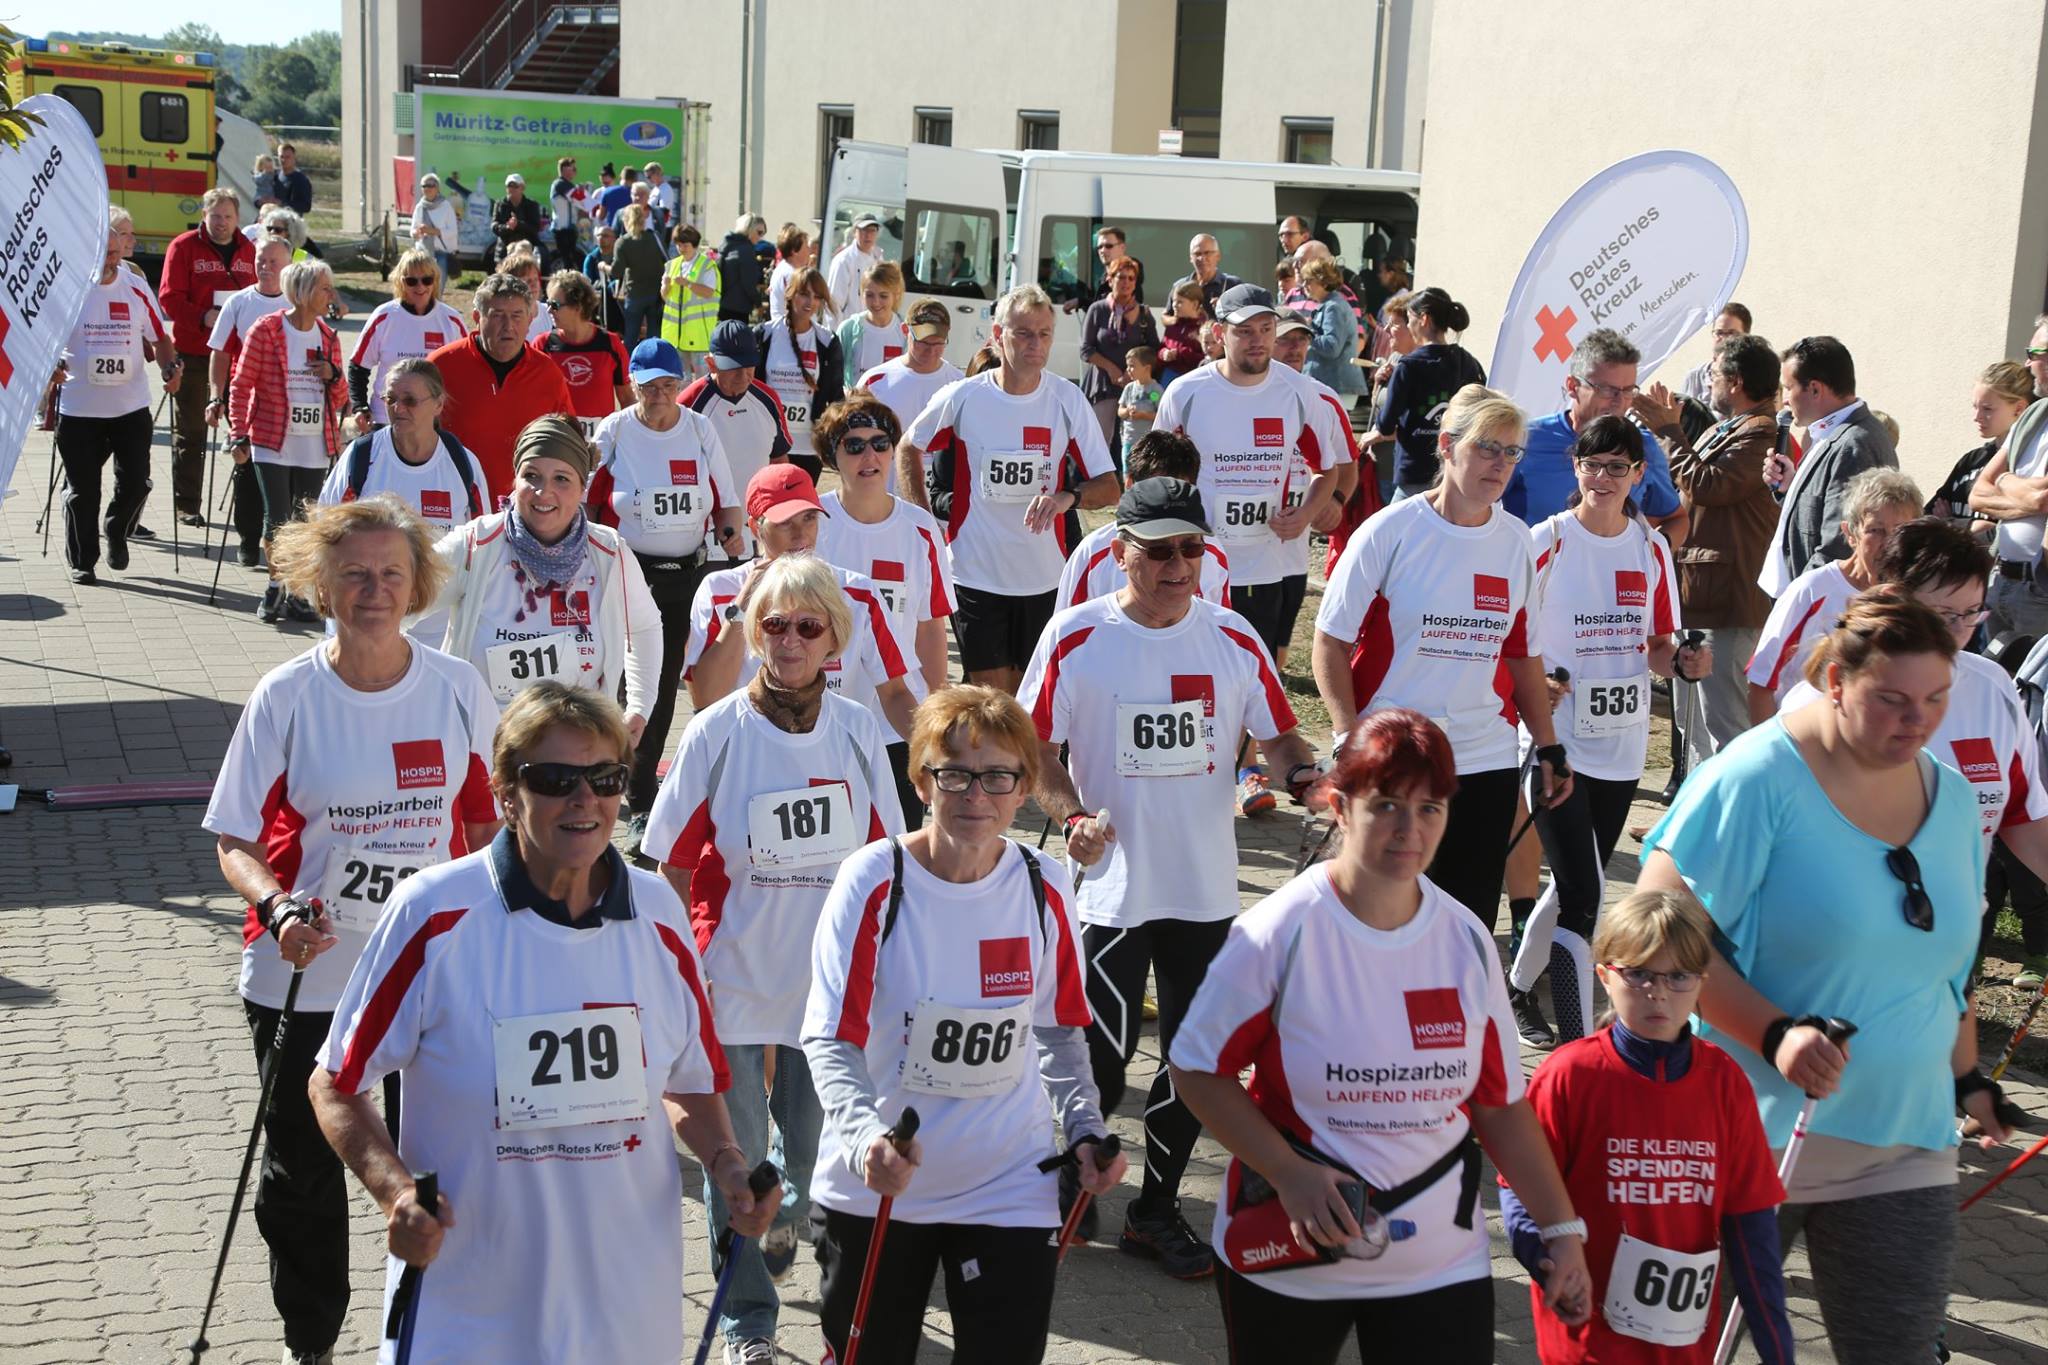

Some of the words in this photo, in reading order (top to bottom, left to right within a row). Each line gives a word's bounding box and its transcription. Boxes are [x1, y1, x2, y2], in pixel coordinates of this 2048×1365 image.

[435, 111, 612, 136] Müritz-Getränke
[0, 145, 63, 280] Deutsches
[1569, 206, 1660, 291] Deutsches
[7, 226, 48, 304] Rotes
[20, 250, 63, 329] Kreuz
[1580, 258, 1631, 307] Rotes
[1590, 275, 1643, 325] Kreuz
[1640, 271, 1700, 320] Menschen.
[95, 358, 125, 374] 284
[292, 407, 320, 424] 556
[1214, 451, 1283, 463] Hospizarbeit
[990, 460, 1034, 485] 585
[654, 492, 692, 516] 514
[1226, 501, 1267, 526] 584
[1476, 594, 1508, 605] HOSPIZ
[1422, 614, 1508, 631] Hospizarbeit
[1575, 628, 1614, 638] LAUFEND
[1421, 630, 1467, 640] LAUFEND
[509, 644, 557, 679] 311
[1590, 685, 1639, 716] 533
[1134, 712, 1195, 750] 636
[400, 766, 443, 778] HOSPIZ
[328, 795, 443, 819] Hospizarbeit
[773, 796, 830, 840] 187
[331, 821, 389, 836] LAUFEND
[392, 817, 442, 829] HELFEN
[371, 841, 397, 849] Rotes
[399, 841, 425, 849] Kreuz
[751, 875, 790, 884] Deutsches
[985, 971, 1031, 985] HOSPIZ
[1415, 1022, 1463, 1036] HOSPIZ
[931, 1018, 1016, 1066] 866
[528, 1024, 619, 1086] 219
[1326, 1060, 1468, 1087] Hospizarbeit
[1326, 1090, 1406, 1102] LAUFEND
[1412, 1087, 1463, 1102] HELFEN
[1327, 1116, 1386, 1129] Deutsches
[1389, 1120, 1420, 1129] Rotes
[496, 1143, 554, 1156] Deutsches
[557, 1143, 591, 1154] Rotes
[594, 1141, 621, 1152] Kreuz
[1607, 1138, 1639, 1154] DIE
[1643, 1139, 1716, 1157] KLEINEN
[1607, 1159, 1716, 1180] SPENDEN
[1607, 1181, 1715, 1206] HELFEN
[1634, 1259, 1715, 1312] 603
